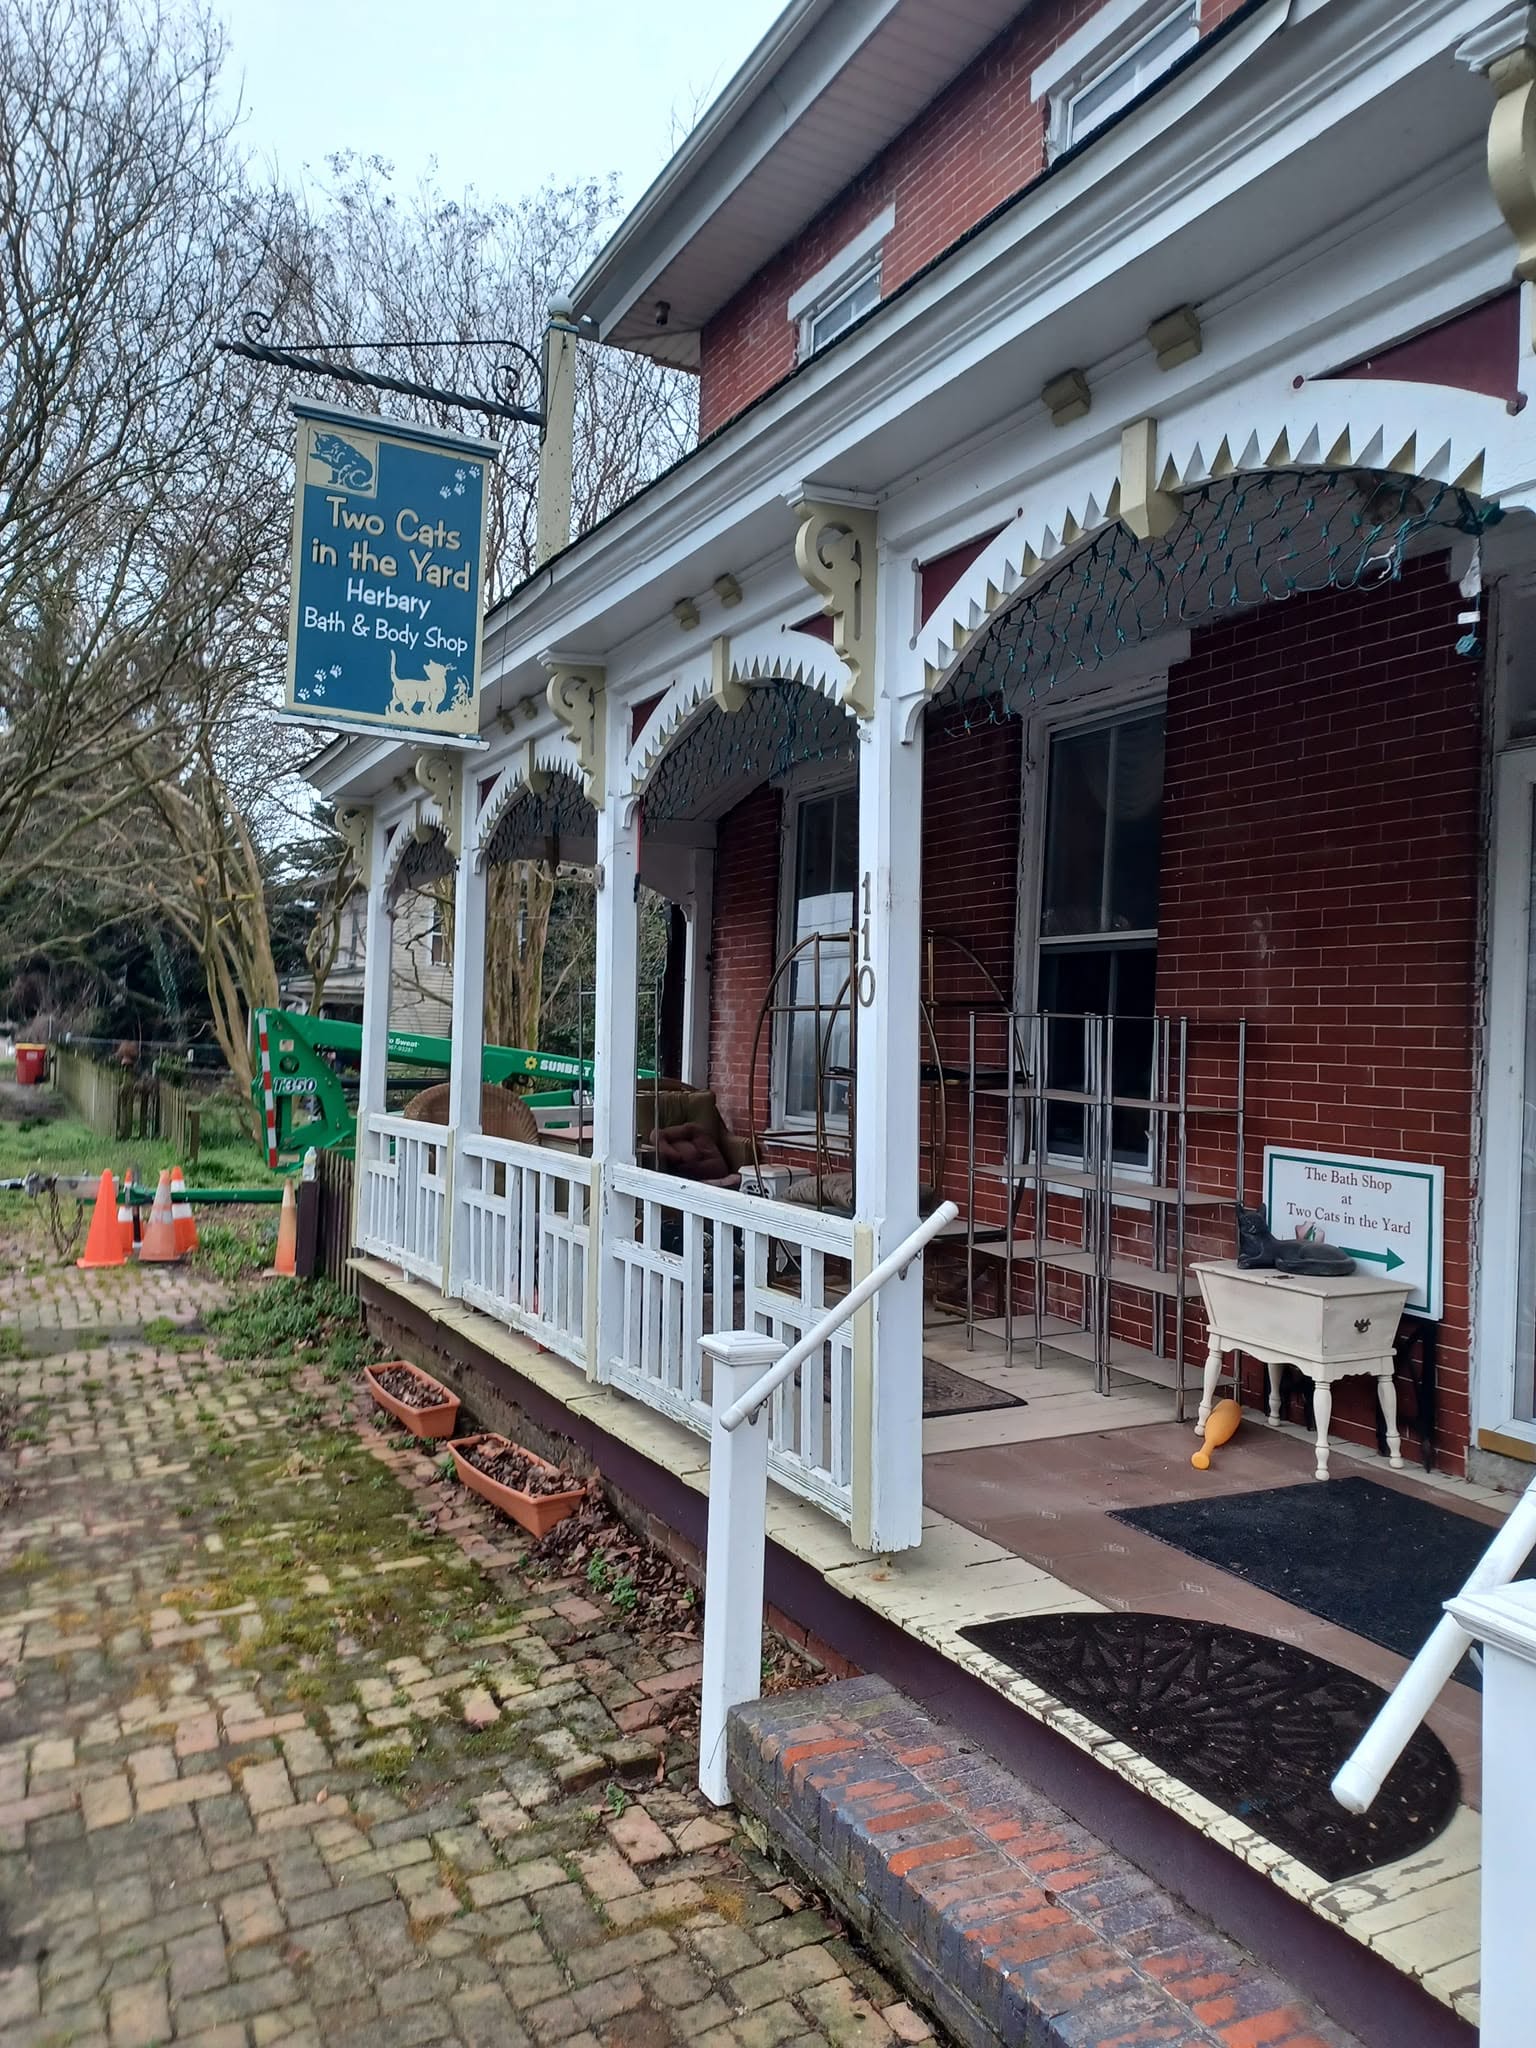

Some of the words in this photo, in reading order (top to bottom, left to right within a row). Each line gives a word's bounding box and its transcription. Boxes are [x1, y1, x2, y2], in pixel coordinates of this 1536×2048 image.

[326, 495, 385, 536] Two
[396, 508, 462, 551] Cats
[311, 537, 338, 567] in
[348, 540, 398, 577] the
[409, 549, 471, 592] Yard
[346, 578, 431, 620] Herbary
[304, 606, 345, 633] Bath
[352, 613, 371, 637] &
[375, 618, 420, 650] Body
[423, 626, 468, 657] Shop
[858, 871, 876, 1008] 110
[273, 1077, 318, 1095] T350
[540, 1059, 592, 1077] SUNBET
[1304, 1166, 1328, 1182] The
[1331, 1170, 1358, 1187] Bath
[1362, 1174, 1392, 1194] Shop
[1287, 1202, 1312, 1218] Two
[1314, 1206, 1341, 1224] Cats
[1343, 1212, 1355, 1226] in
[1359, 1214, 1378, 1229] the
[1381, 1217, 1411, 1235] Yard
[1341, 1194, 1352, 1206] at
